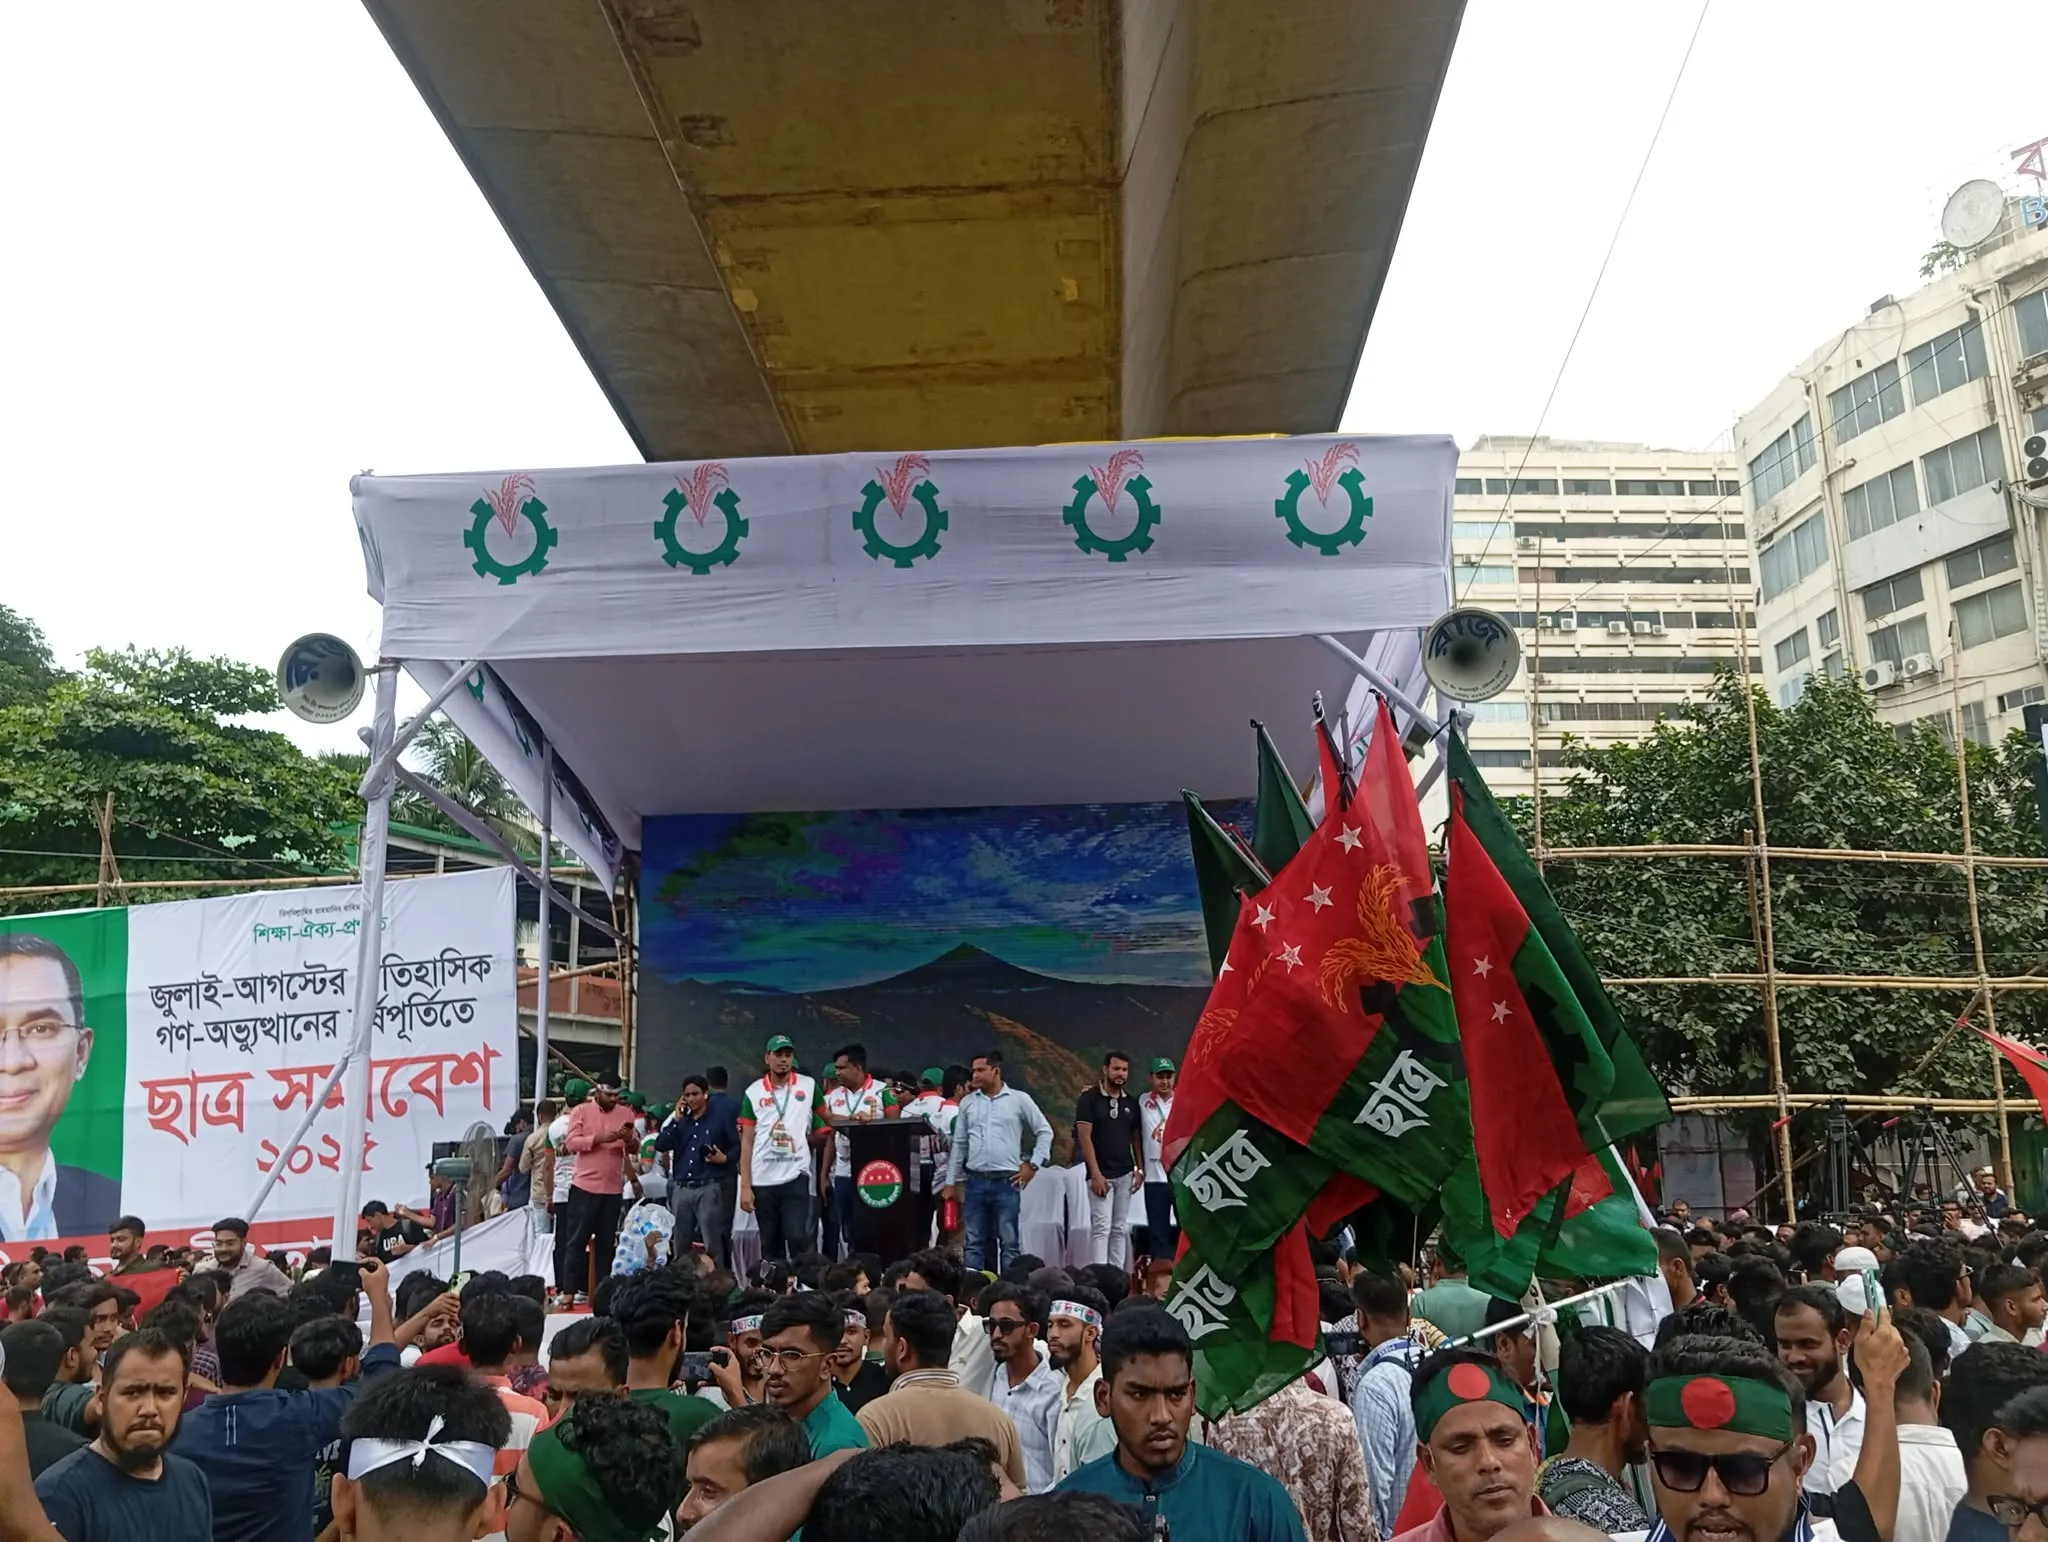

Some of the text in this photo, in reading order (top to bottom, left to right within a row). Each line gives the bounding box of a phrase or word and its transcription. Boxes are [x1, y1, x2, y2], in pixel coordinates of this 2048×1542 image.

[148, 947, 493, 1020] জুলাই-আগস্টের তিহাসিক
[347, 989, 478, 1043] র্ষপূর্তিতে
[139, 1068, 255, 1146] ছাত্র
[1353, 1049, 1449, 1138] ছাত্র
